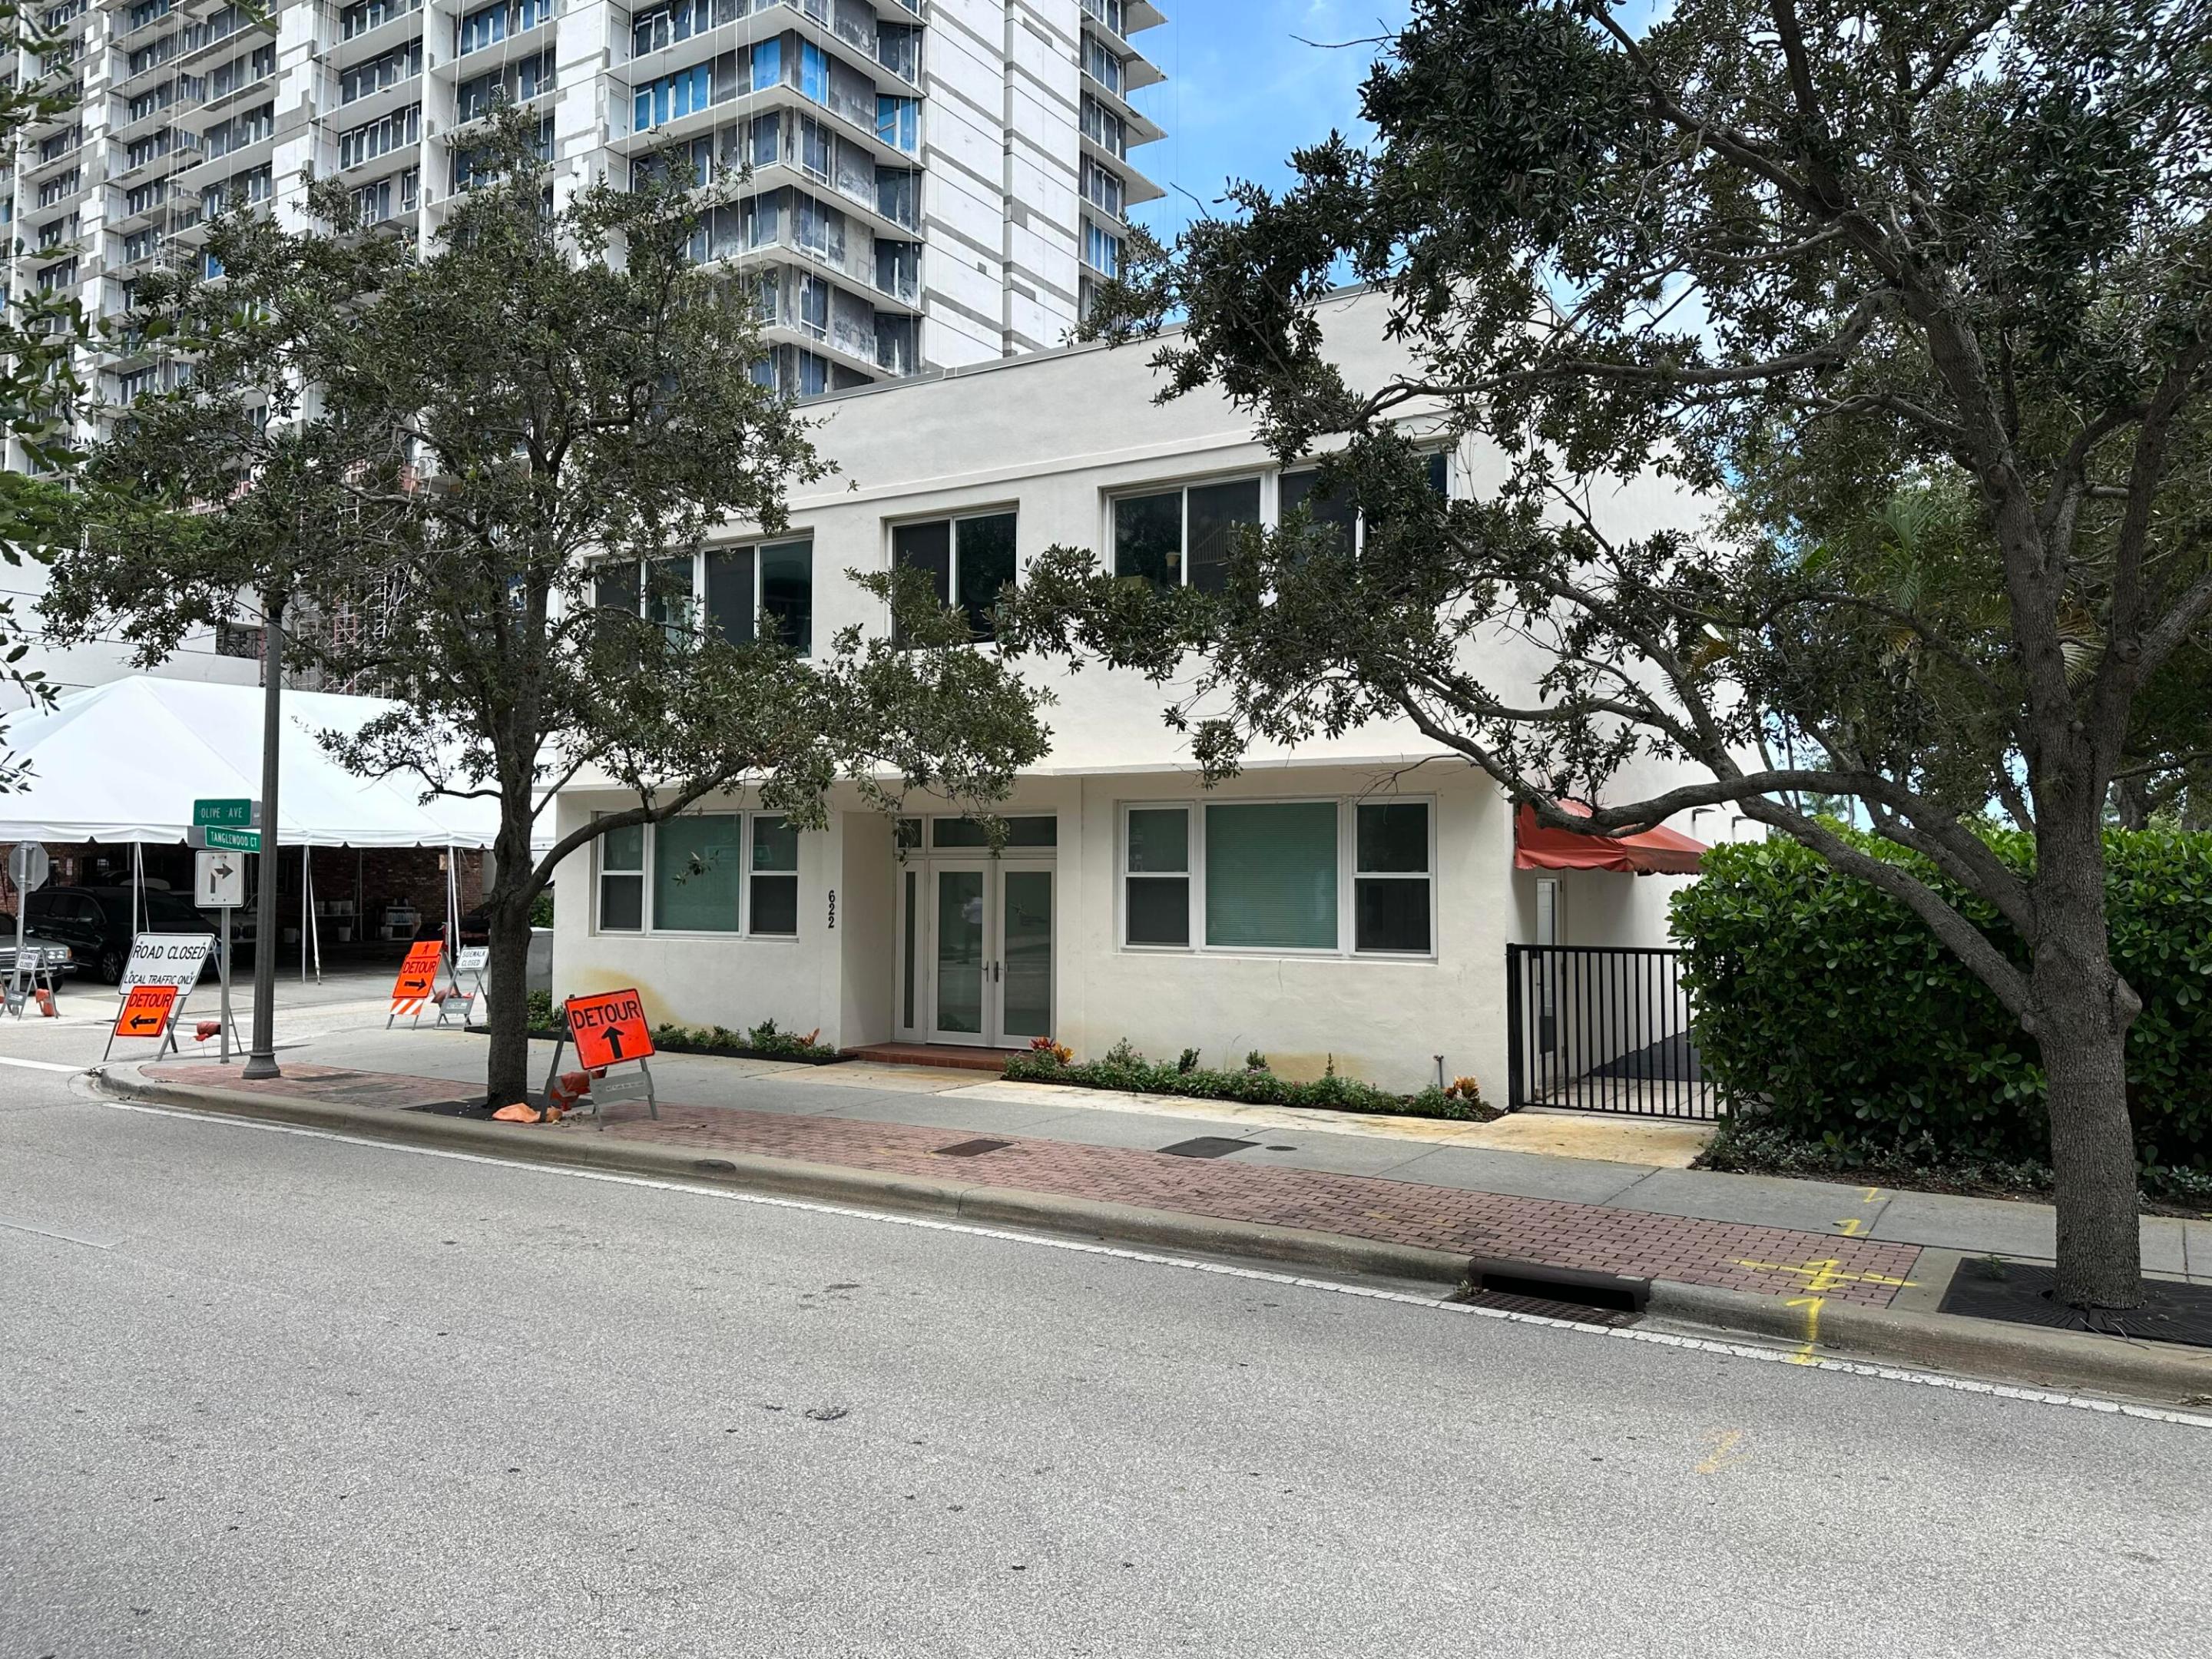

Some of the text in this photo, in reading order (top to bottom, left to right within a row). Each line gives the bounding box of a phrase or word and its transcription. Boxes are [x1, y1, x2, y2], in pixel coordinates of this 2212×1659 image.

[200, 806, 221, 819] OLIVE
[228, 806, 243, 818] AVE
[210, 831, 257, 847] TANGLEWOOD CT
[132, 945, 207, 959] ROAD CLOSED
[402, 961, 437, 974] DETOUR
[124, 974, 195, 985] LOCAL TRAFFIC ONLY
[128, 993, 172, 1008] DETOUR
[571, 1000, 641, 1030] DETOUR
